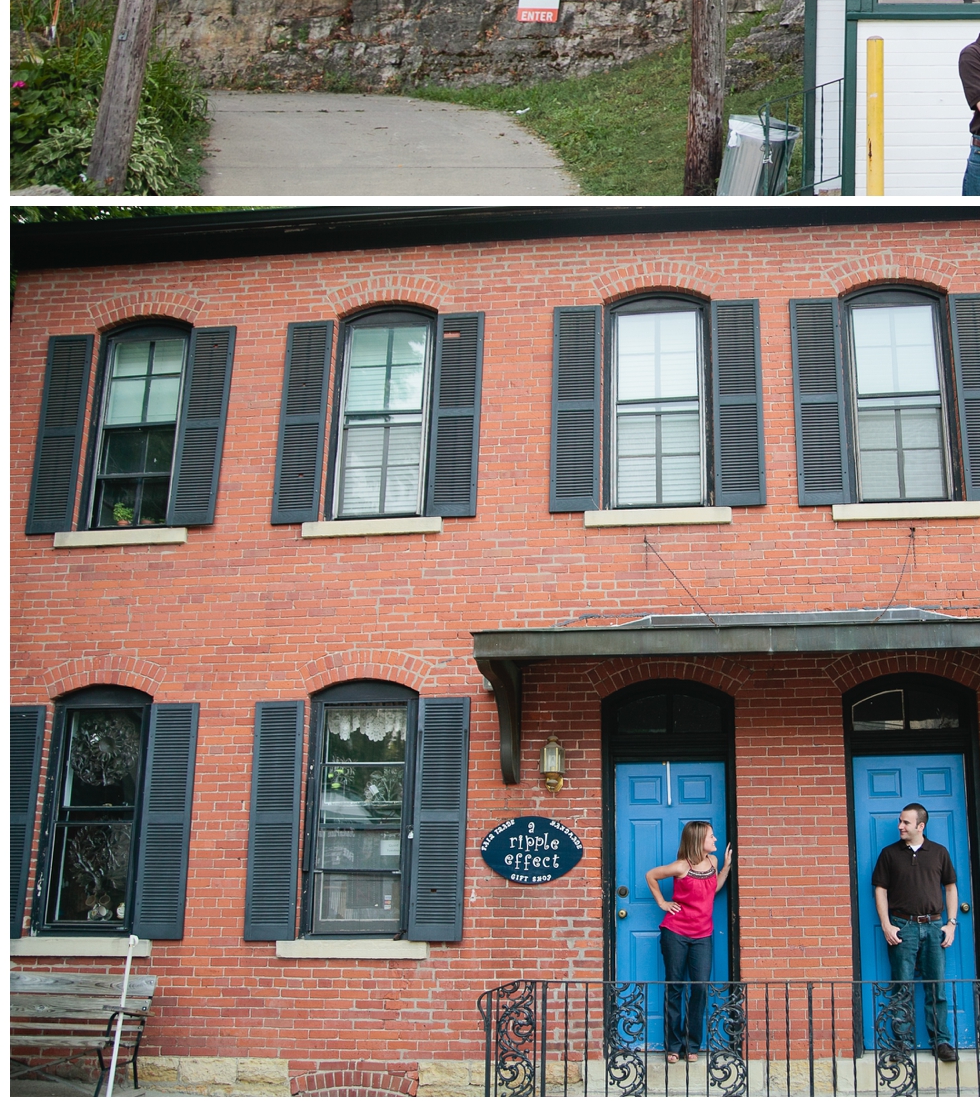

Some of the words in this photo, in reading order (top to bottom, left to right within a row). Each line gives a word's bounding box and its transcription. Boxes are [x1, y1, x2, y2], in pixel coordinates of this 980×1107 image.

[521, 11, 553, 21] ENTER
[494, 819, 516, 835] TRADE
[528, 821, 535, 834] a
[509, 832, 560, 852] ripple
[504, 852, 560, 871] effect
[510, 873, 529, 882] GIFT
[532, 874, 552, 882] SHOP
